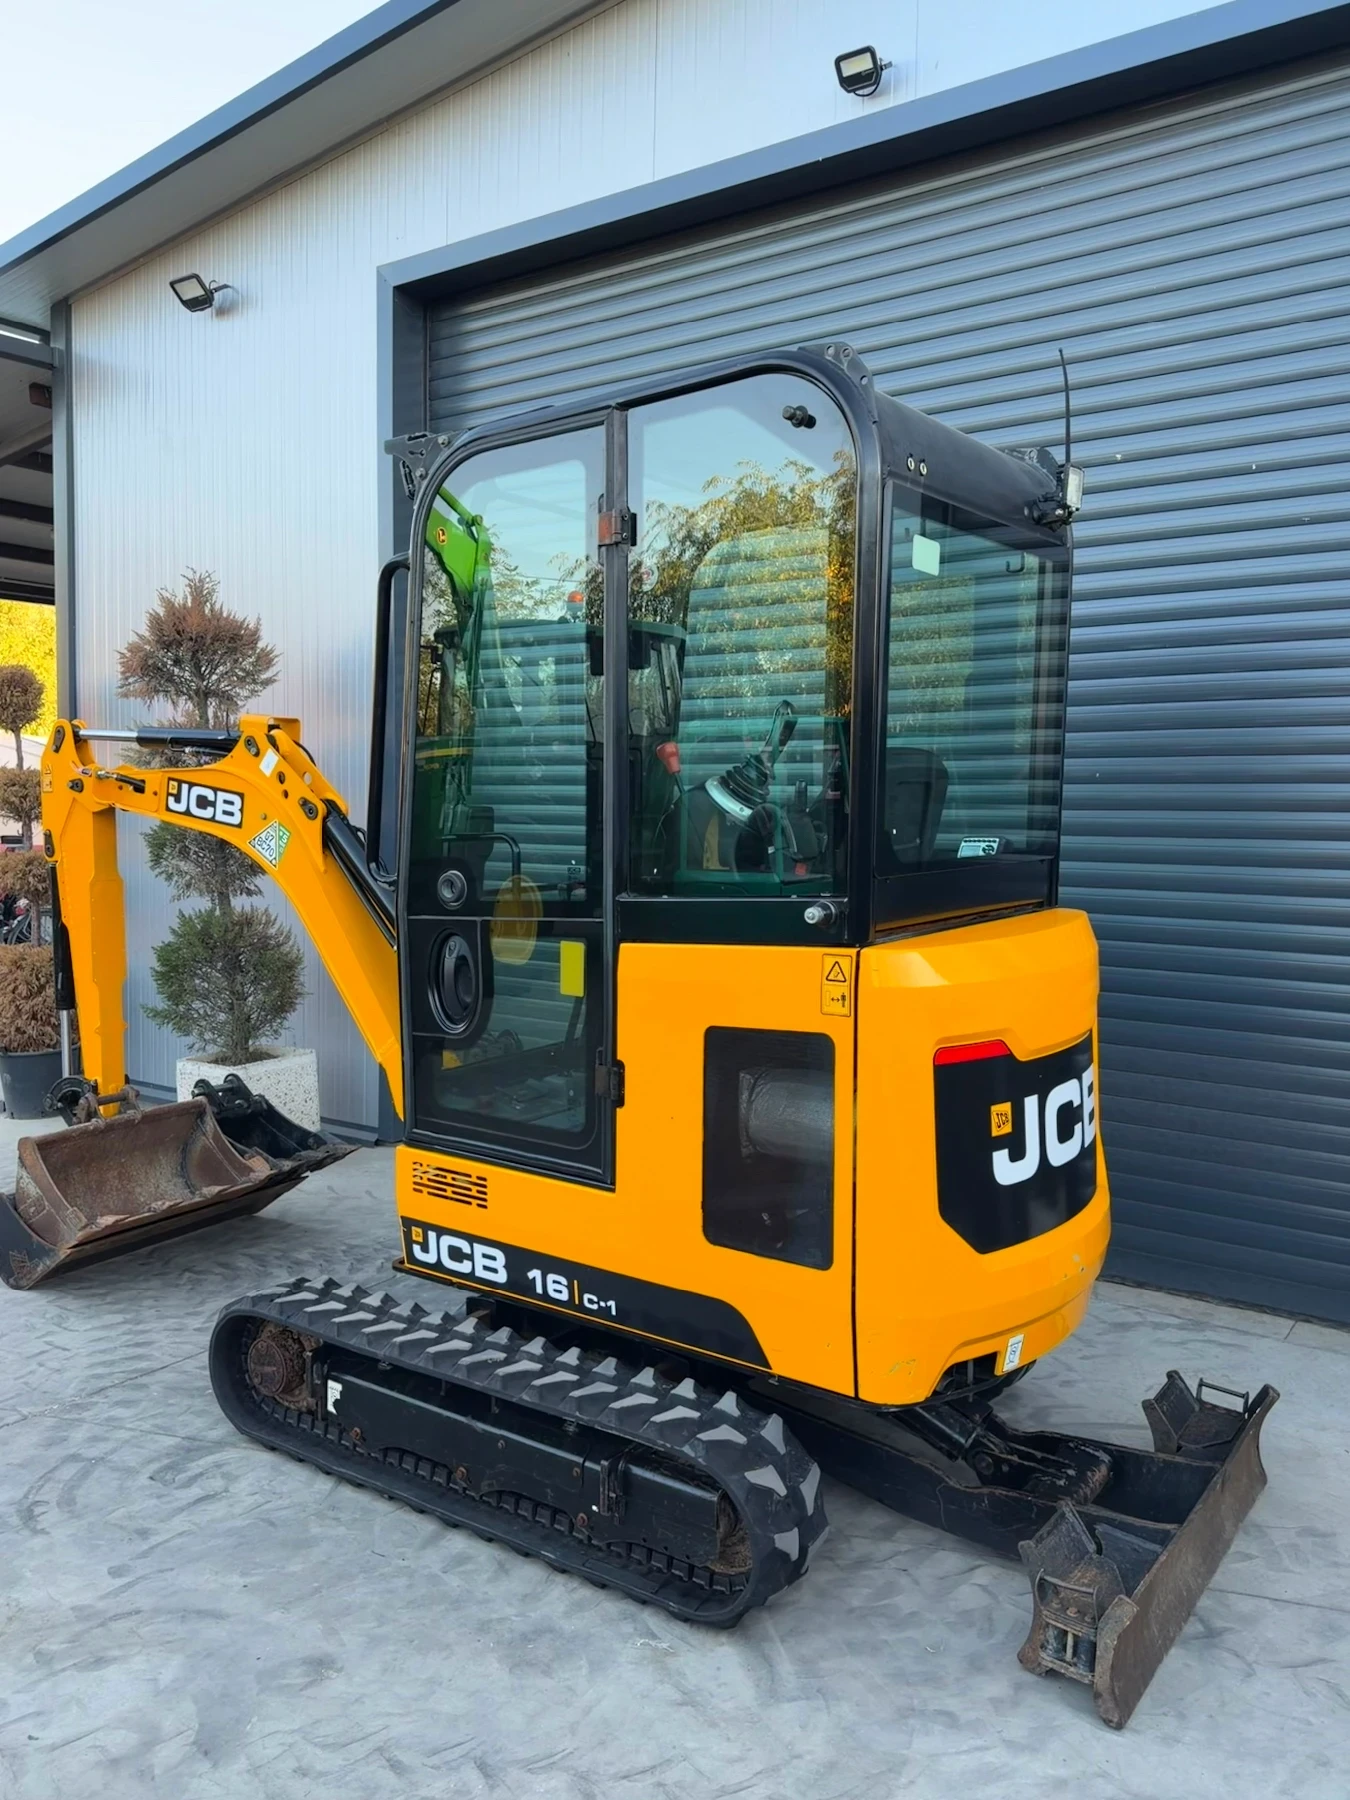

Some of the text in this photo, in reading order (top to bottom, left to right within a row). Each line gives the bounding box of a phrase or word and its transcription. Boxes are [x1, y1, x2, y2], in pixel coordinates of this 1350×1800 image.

[168, 783, 242, 825] JCB
[412, 1230, 507, 1284] JCB
[527, 1268, 569, 1302] 16
